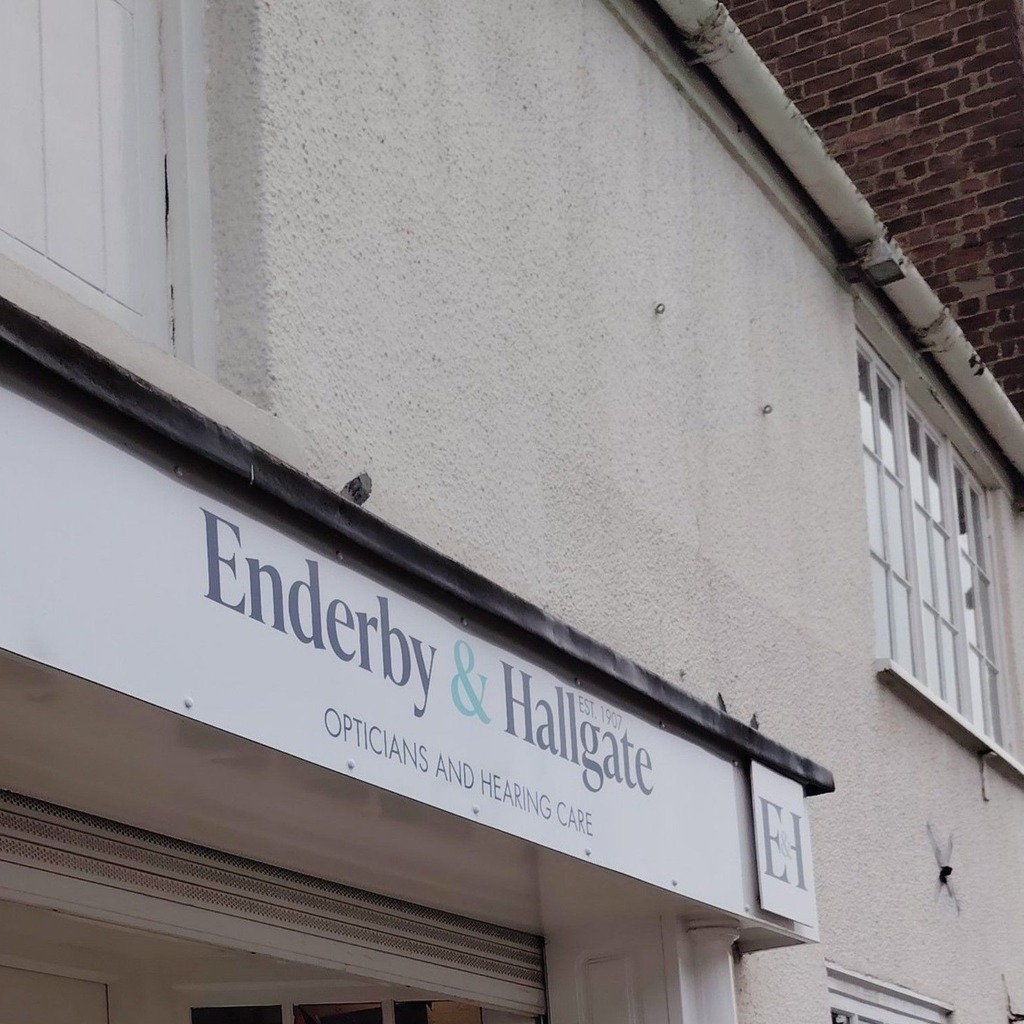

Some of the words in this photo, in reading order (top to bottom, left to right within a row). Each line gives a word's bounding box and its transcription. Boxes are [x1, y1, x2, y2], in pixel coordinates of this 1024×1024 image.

[201, 507, 437, 718] Enderby
[451, 639, 492, 725] &
[500, 660, 655, 796] Hallgate
[578, 695, 598, 720] EST.
[600, 704, 623, 731] 1907
[324, 707, 429, 773] OPTICIANS
[435, 753, 475, 790] AND
[481, 769, 552, 820] HEARING
[556, 801, 594, 837] CARE
